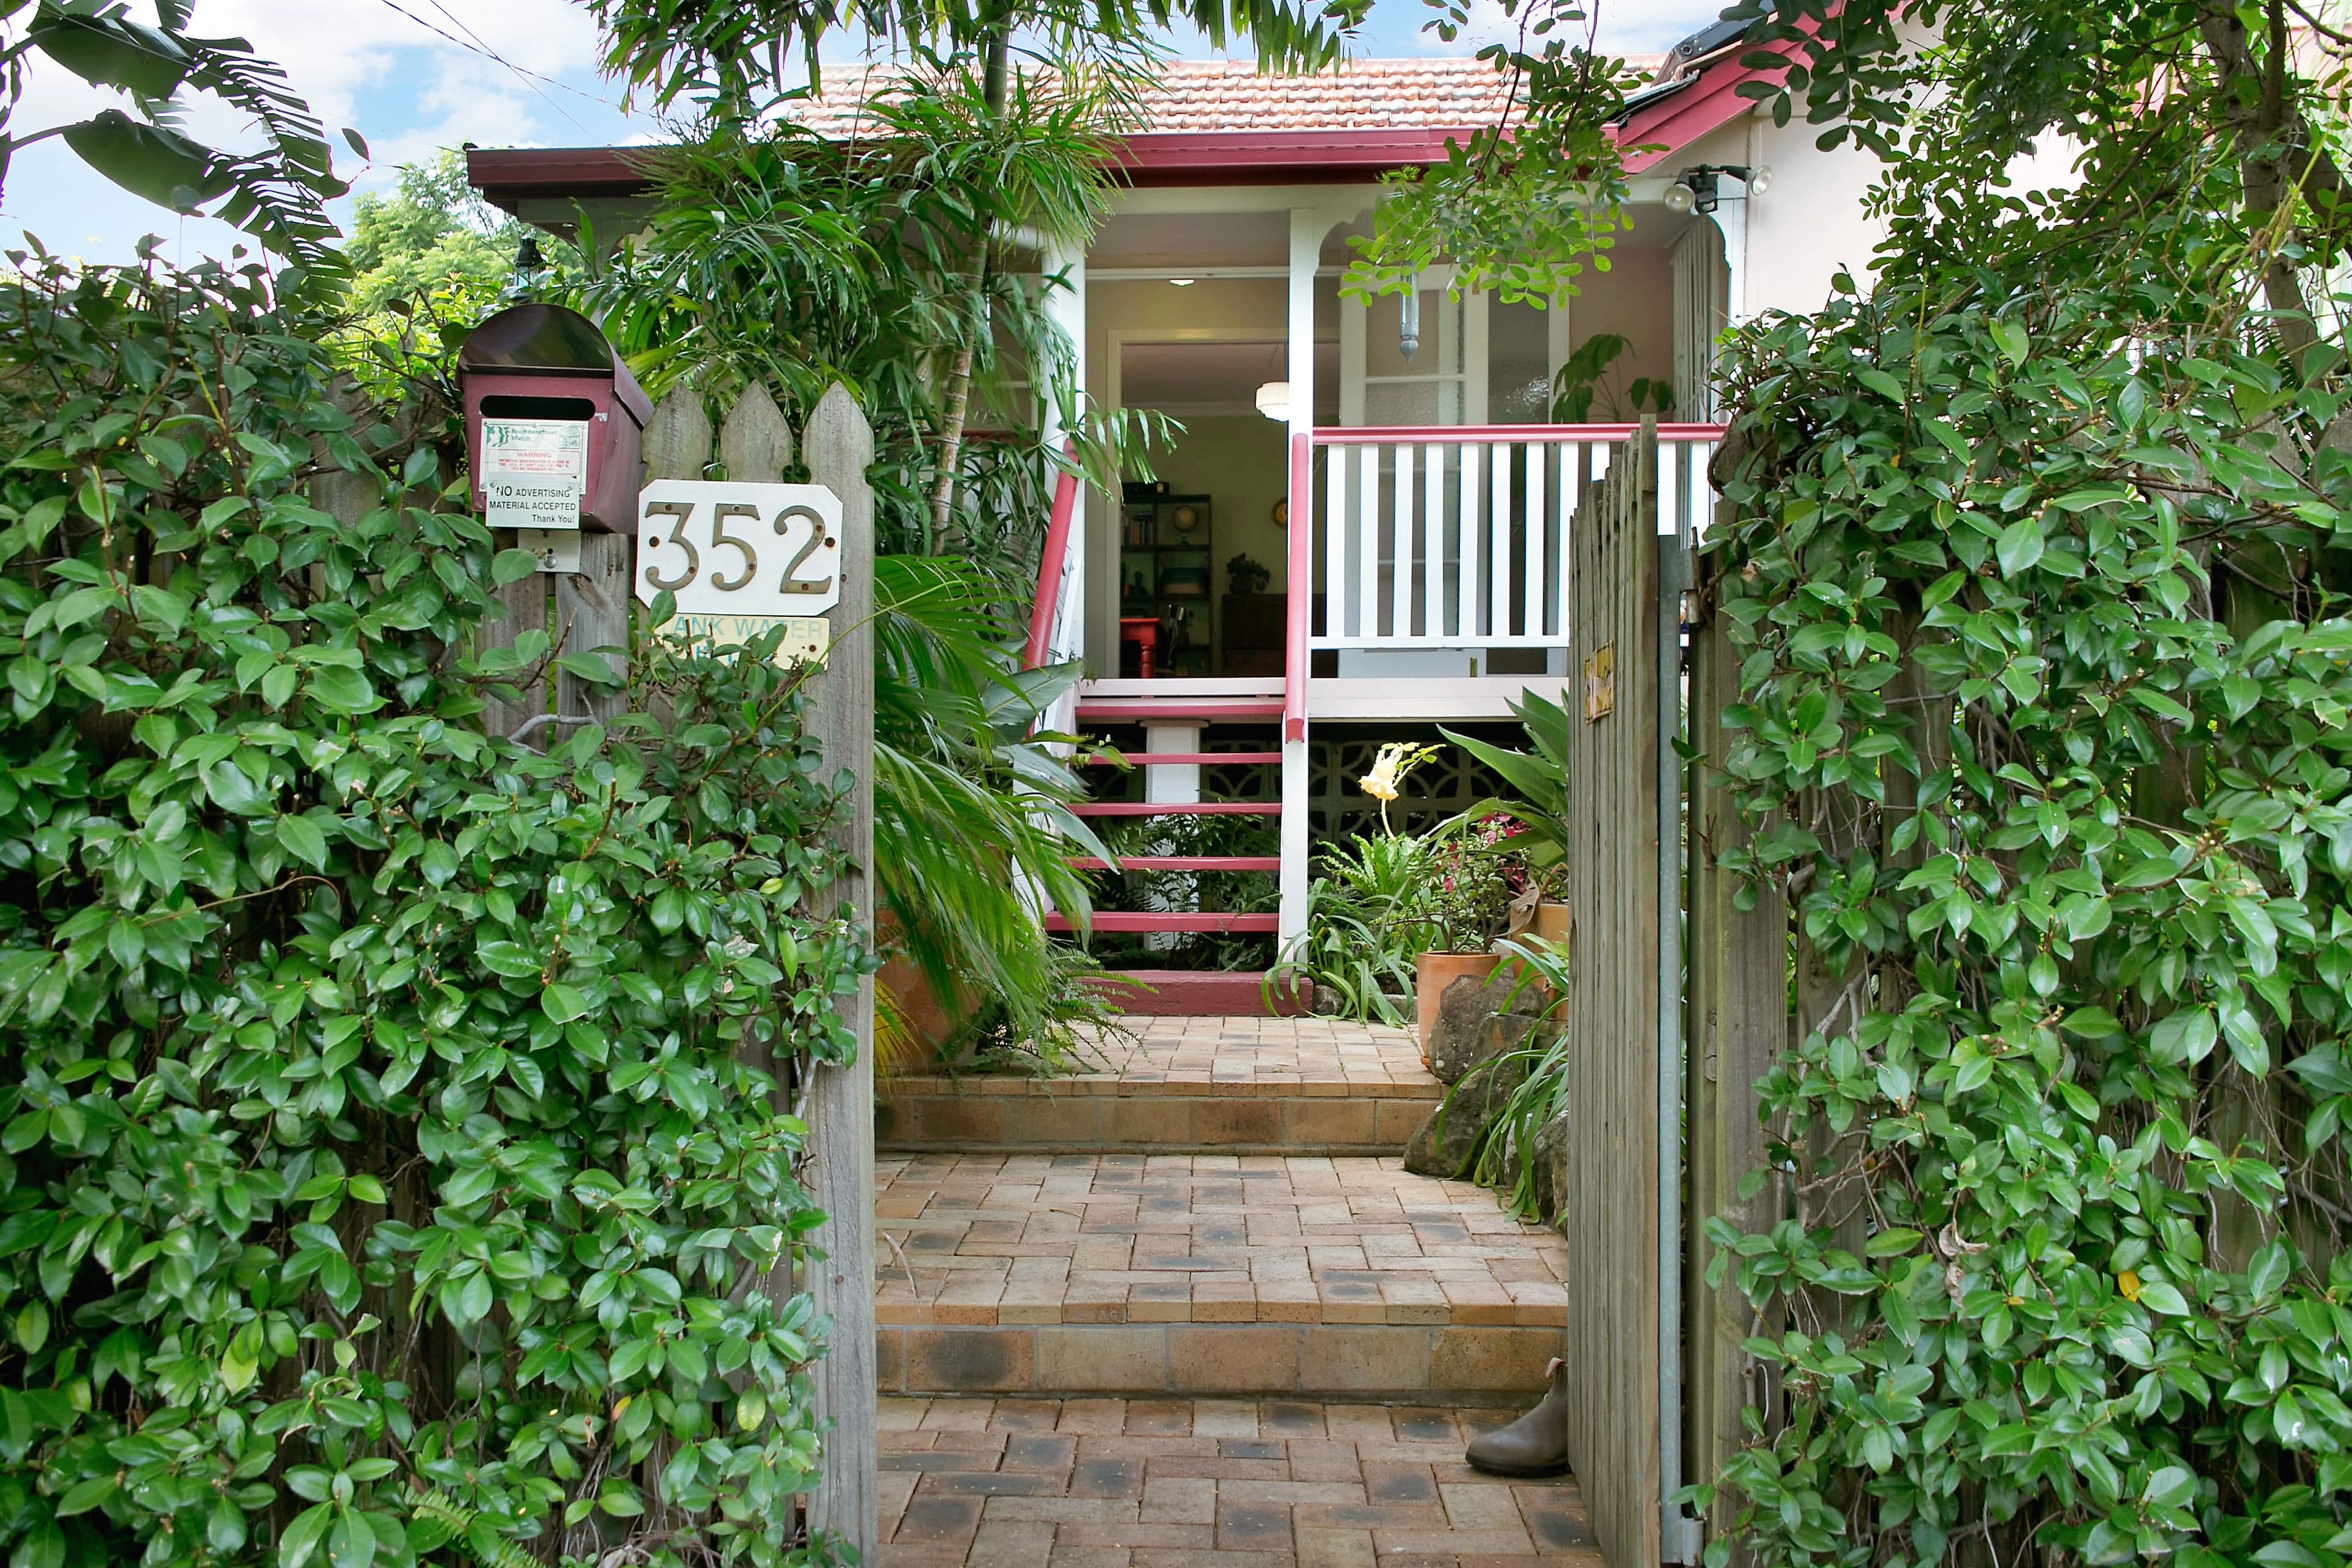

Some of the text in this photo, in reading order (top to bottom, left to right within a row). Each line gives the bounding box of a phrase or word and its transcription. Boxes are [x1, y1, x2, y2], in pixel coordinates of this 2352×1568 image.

[496, 486, 571, 498] NO ADVERTISING
[489, 501, 576, 511] MATERIAL ACCEPTED
[532, 514, 556, 523] Thank
[645, 501, 832, 594] 352
